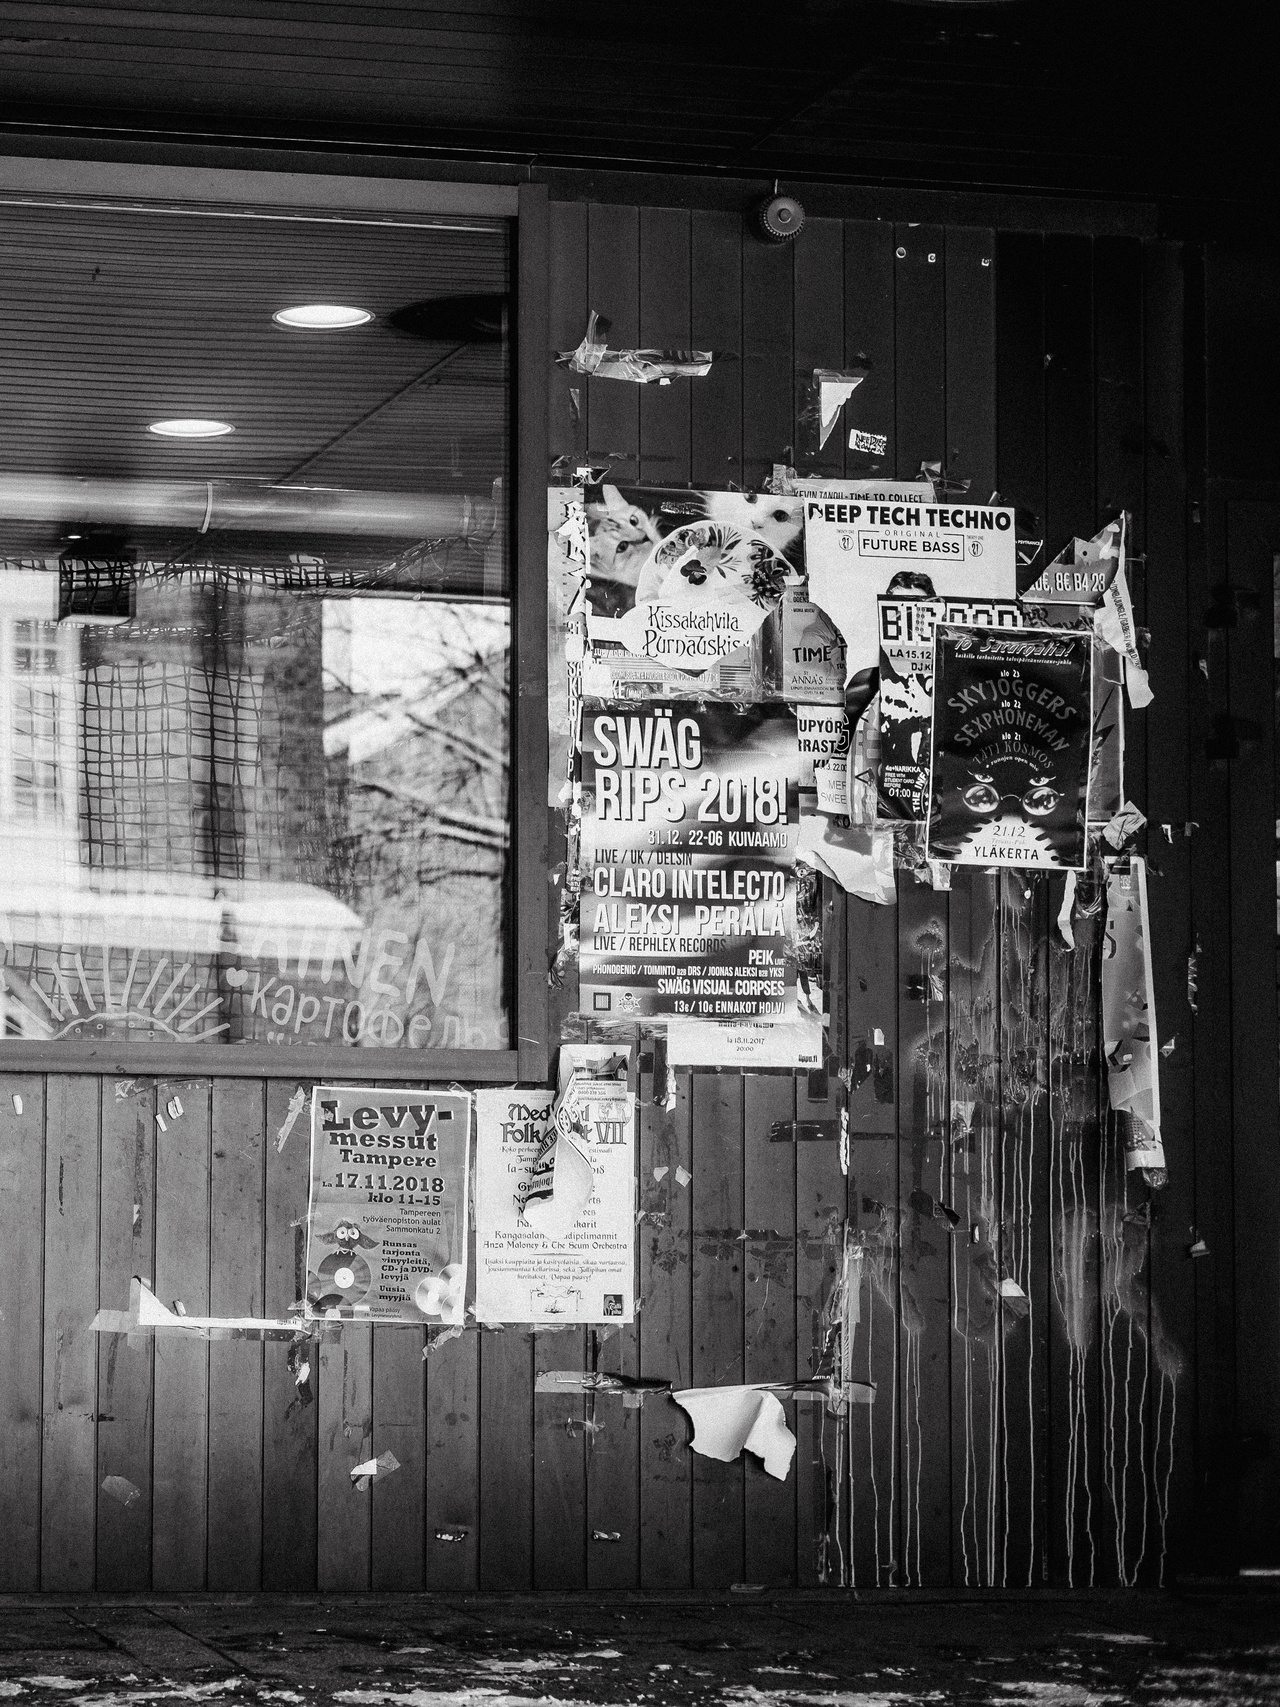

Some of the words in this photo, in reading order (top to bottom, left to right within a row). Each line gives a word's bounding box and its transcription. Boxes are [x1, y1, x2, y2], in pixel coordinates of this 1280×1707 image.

[850, 492, 869, 501] TIME
[874, 493, 886, 501] TO
[889, 494, 923, 503] COLLECT
[867, 505, 920, 526] TECH
[926, 509, 1011, 531] TECHNO
[885, 529, 940, 538] ORIGINAL
[863, 538, 917, 551] FUTURE
[923, 541, 960, 553] BASS
[1056, 573, 1071, 592] 8€
[1075, 573, 1089, 592] B4
[1092, 573, 1106, 592] 23
[648, 605, 743, 632] Kissakahvila
[642, 629, 740, 658] Purnauskis
[793, 646, 831, 663] TIME
[890, 649, 904, 658] LA
[905, 650, 931, 659] 15.12
[911, 663, 923, 671] DJ
[792, 674, 823, 684] ANNA'S
[1012, 670, 1021, 678] 23
[947, 678, 1077, 720] SKYJOGGERS
[1001, 700, 1011, 708] klo
[1013, 700, 1021, 709] 22
[954, 709, 1070, 750] SEXPHONEMAN
[1001, 732, 1011, 740] klo
[1014, 732, 1021, 740] 21
[593, 708, 703, 770] SWÄG
[1004, 741, 1054, 769] KOSMOS
[1014, 756, 1028, 765] open
[595, 768, 687, 822] RIPS
[697, 771, 789, 825] 2018!
[889, 788, 911, 798] 01:00
[992, 825, 1026, 838] 21.12
[648, 830, 683, 846] 31.12.
[689, 830, 723, 846] 22-06
[729, 831, 788, 848] KUIVAAMO
[595, 848, 618, 864] LIVE
[631, 850, 644, 864] UK
[657, 850, 693, 866] DELSIN
[974, 845, 1039, 860] YLÄKERTA
[593, 867, 666, 898] CLARO
[671, 869, 786, 901] INTELECTO
[593, 902, 680, 935] ALEKSI
[695, 900, 786, 937] PERÄLÄ
[593, 936, 617, 951] LIVE
[629, 937, 676, 952] REPHLEX
[679, 937, 727, 953] RECORDS
[749, 950, 774, 965] PEIK
[592, 964, 636, 975] PHONOGENIC
[644, 965, 676, 976] TOIMINTO
[688, 966, 702, 977] DRS
[708, 966, 733, 977] JOONAS
[734, 967, 758, 977] ALEKSI
[770, 968, 785, 978] YKSI
[657, 976, 690, 995] SWÄG
[693, 979, 733, 996] VISUAL
[735, 980, 785, 997] CORPSES
[715, 1001, 757, 1014] ENNAKOT
[759, 1002, 785, 1014] HOLVI
[734, 1036, 765, 1045] 18.11.2017
[321, 1100, 453, 1136] Levy-
[500, 1122, 542, 1143] Folk
[594, 1121, 627, 1145] VII
[330, 1131, 437, 1150] messut
[340, 1149, 437, 1169] Tampere
[335, 1172, 444, 1193] 17.11.2018
[368, 1192, 394, 1203] klo
[400, 1208, 441, 1218] Tampereen
[362, 1215, 420, 1226] työväenopiston
[422, 1217, 441, 1226] aulat
[386, 1225, 434, 1235] Sammonkatu
[495, 1231, 545, 1242] Kangasalan
[382, 1240, 417, 1249] Runsas
[506, 1241, 539, 1250] Maloney
[551, 1241, 566, 1249] The
[592, 1242, 628, 1250] Orchestra
[382, 1249, 420, 1258] tarjonta
[381, 1257, 431, 1267] vinyyleitä,
[399, 1265, 409, 1274] ja
[380, 1273, 409, 1281] levyjä
[379, 1285, 406, 1293] Uusia
[378, 1293, 411, 1302] myyjiä
